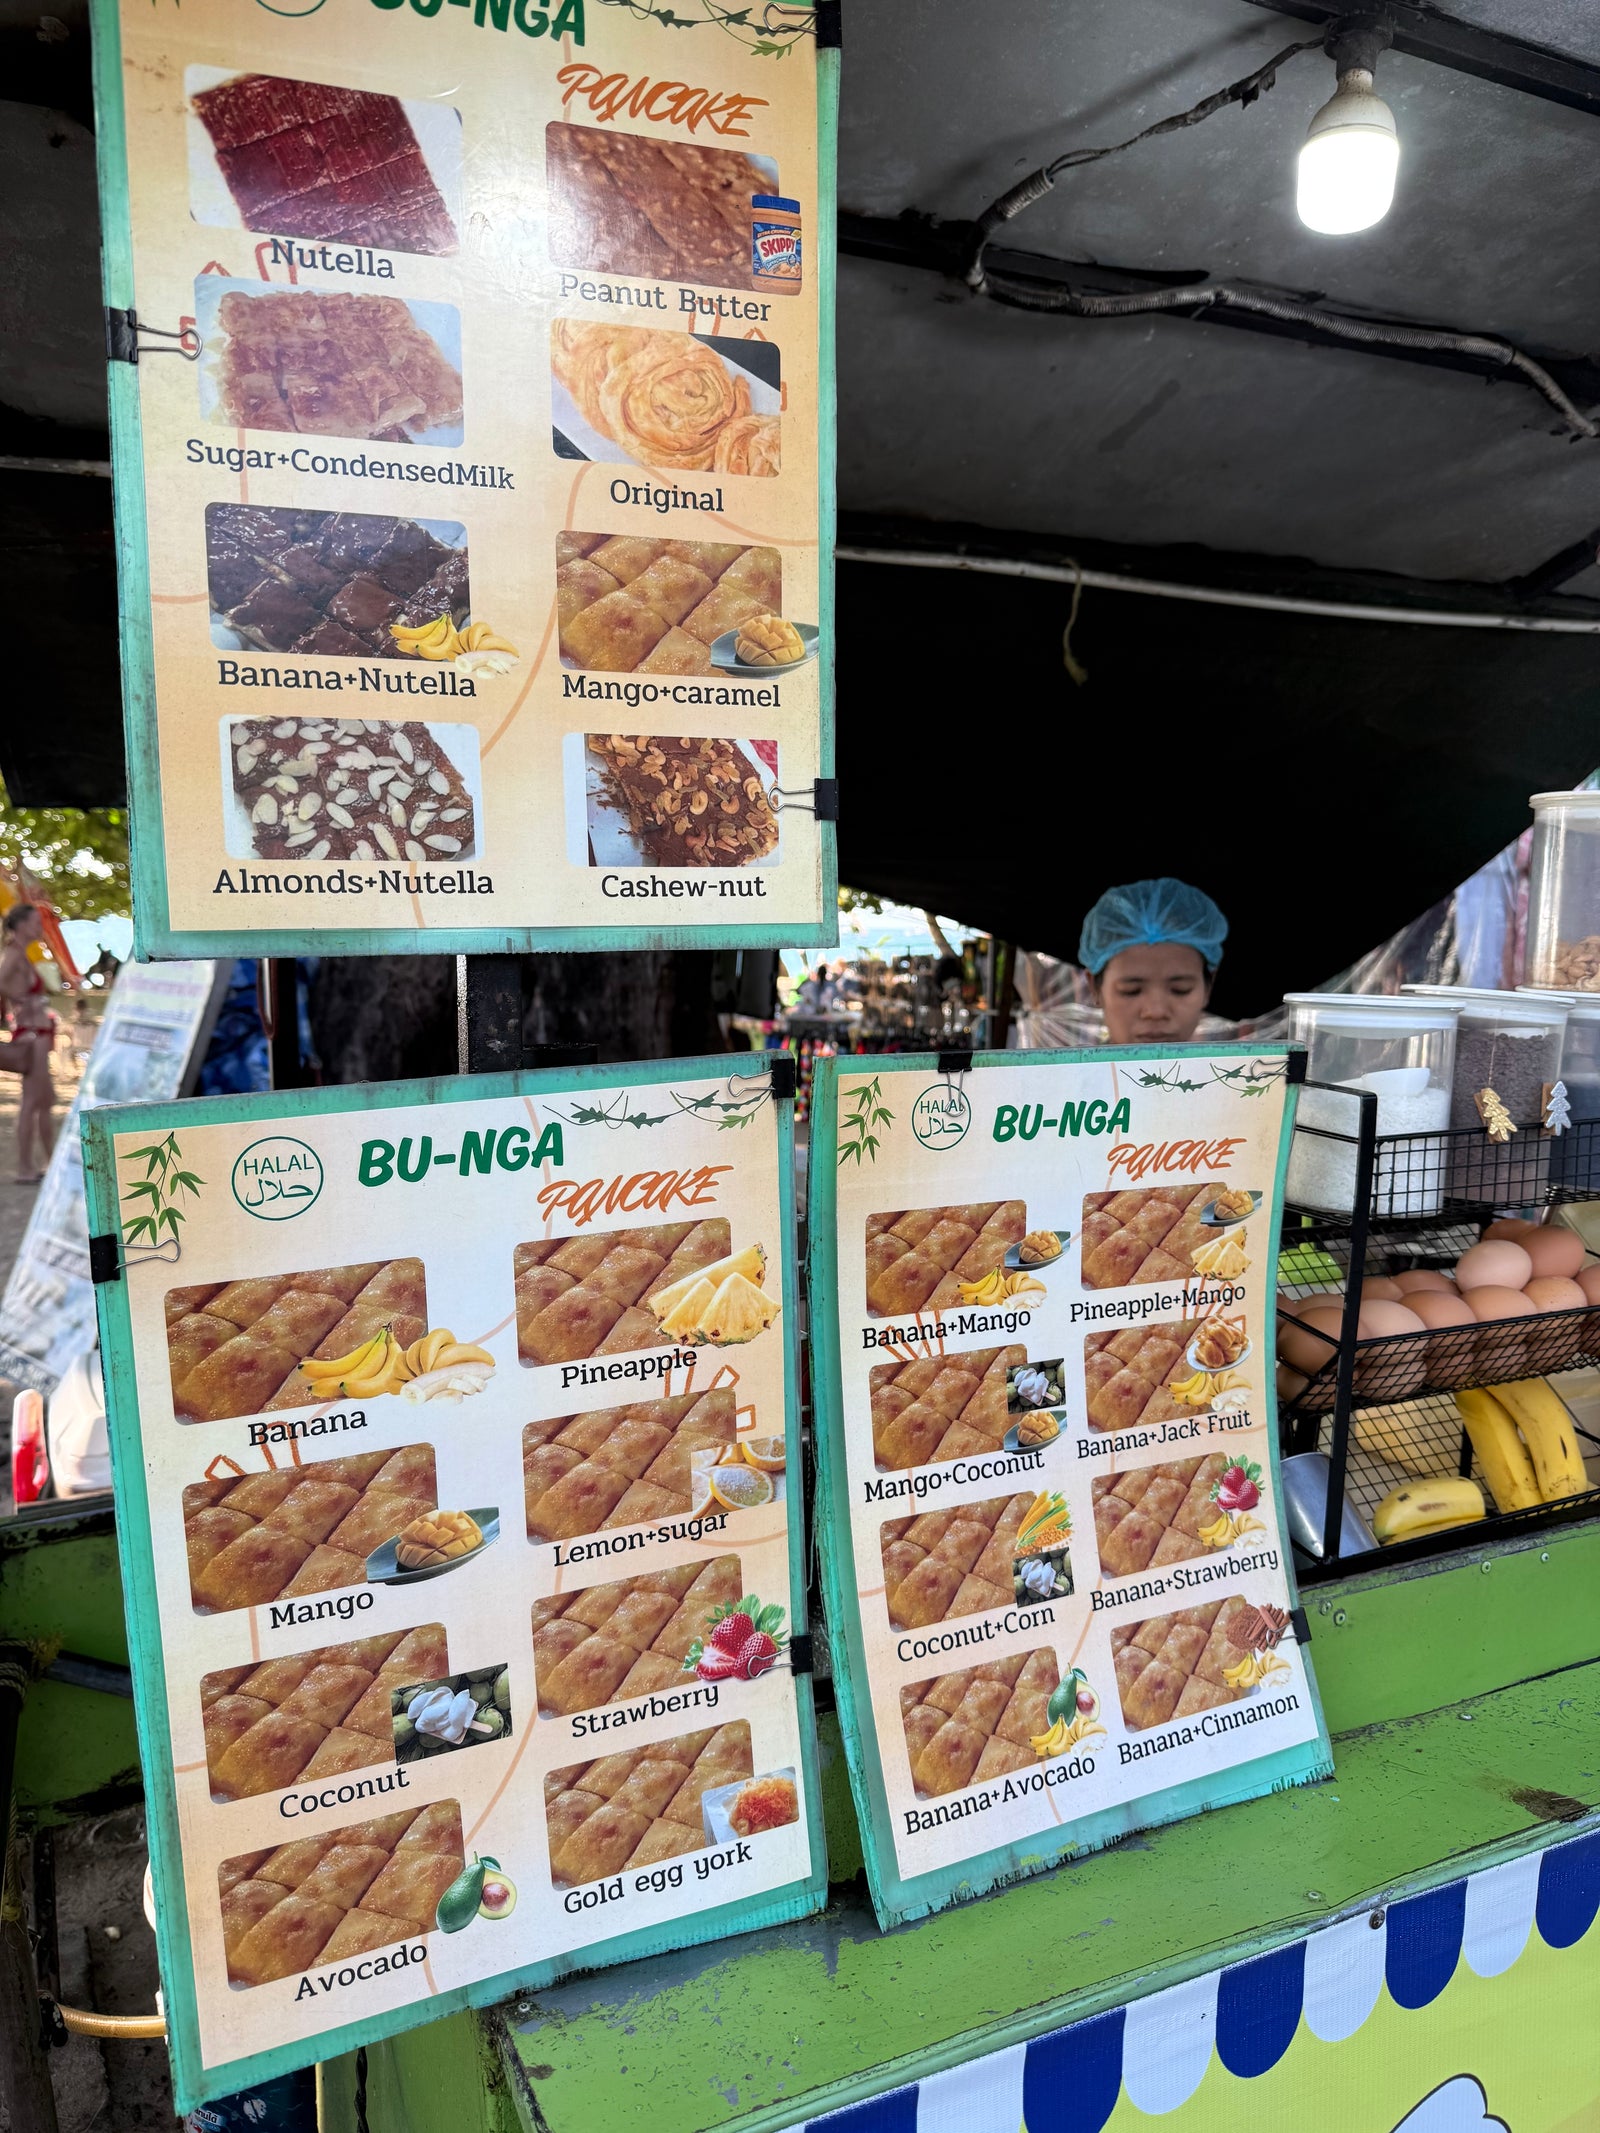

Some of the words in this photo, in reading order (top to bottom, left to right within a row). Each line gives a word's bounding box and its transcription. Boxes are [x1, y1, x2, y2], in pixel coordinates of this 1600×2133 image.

[557, 63, 770, 137] PANCAKE
[270, 237, 396, 279] Nutella
[760, 237, 795, 258] SKIPPY
[558, 272, 668, 311] Peanut
[678, 289, 772, 322] Butter
[185, 438, 516, 492] Sugar+CondensedMilk
[610, 478, 724, 513] Original
[217, 659, 477, 698] Banana+Nutella
[562, 674, 782, 709] Mango+caramel
[212, 868, 495, 896] Almonds+Nutella
[600, 873, 767, 899] Cashew-nut
[919, 1116, 964, 1139] حلال
[992, 1098, 1131, 1143] BU-NGA
[243, 1153, 315, 1176] HALAL
[357, 1122, 564, 1187] BU-NGA
[1107, 1137, 1248, 1182] PANCAKE
[245, 1178, 314, 1207] حلال
[536, 1164, 734, 1226] PANCAKE
[1069, 1284, 1247, 1323] Pineapple+Mango
[861, 1308, 1032, 1349] Banana+Mango
[560, 1346, 698, 1389] Pineapple
[247, 1408, 369, 1446] Banana
[1076, 1420, 1200, 1460] Banana+Jack
[1206, 1410, 1252, 1434] Fruit
[864, 1450, 1045, 1503] Mango+Coconut
[552, 1511, 730, 1568] Lemon+sugar
[1090, 1547, 1280, 1612] Banana+Strawberry
[269, 1590, 375, 1630] Mango
[896, 1605, 1056, 1663] Coconut+Corn
[570, 1683, 721, 1739] Strawberry
[1117, 1692, 1300, 1765] Banana+Cinnamon
[278, 1766, 411, 1819] Coconut
[903, 1755, 1096, 1836] Banana+Avocado
[563, 1877, 626, 1915] Gold
[633, 1866, 684, 1896] egg
[694, 1842, 754, 1880] york
[293, 1943, 428, 2002] Avocado
